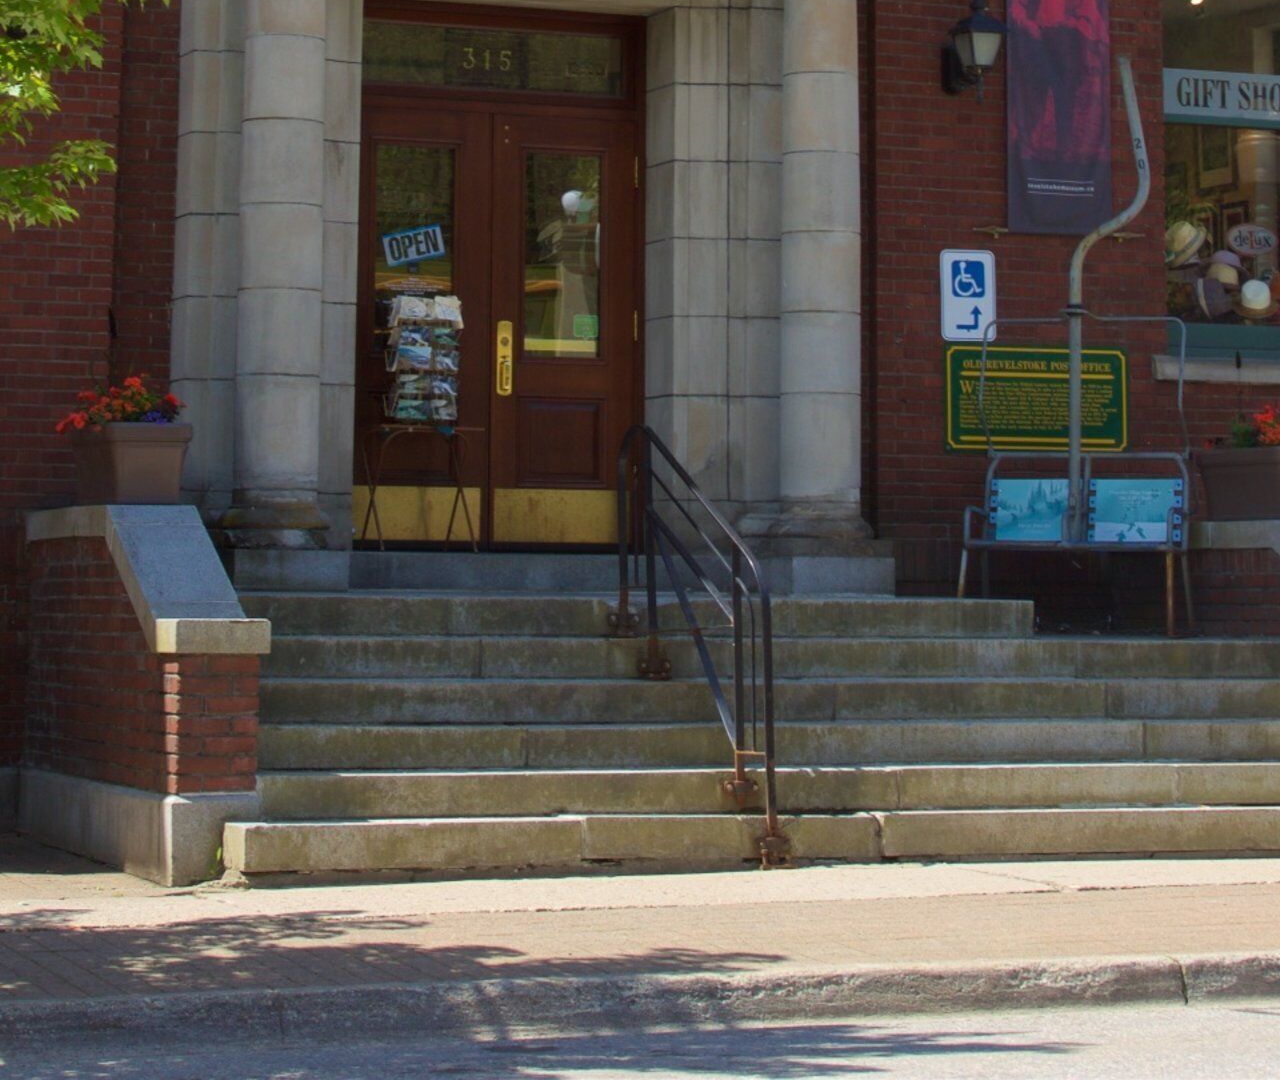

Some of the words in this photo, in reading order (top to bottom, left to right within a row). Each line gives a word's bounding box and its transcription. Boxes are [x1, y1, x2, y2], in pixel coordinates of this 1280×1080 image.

[463, 47, 512, 71] 315
[1176, 77, 1230, 109] GIFT
[388, 228, 440, 261] OPEN
[986, 360, 1047, 370] REVELSTOKE
[1051, 362, 1069, 370] POS
